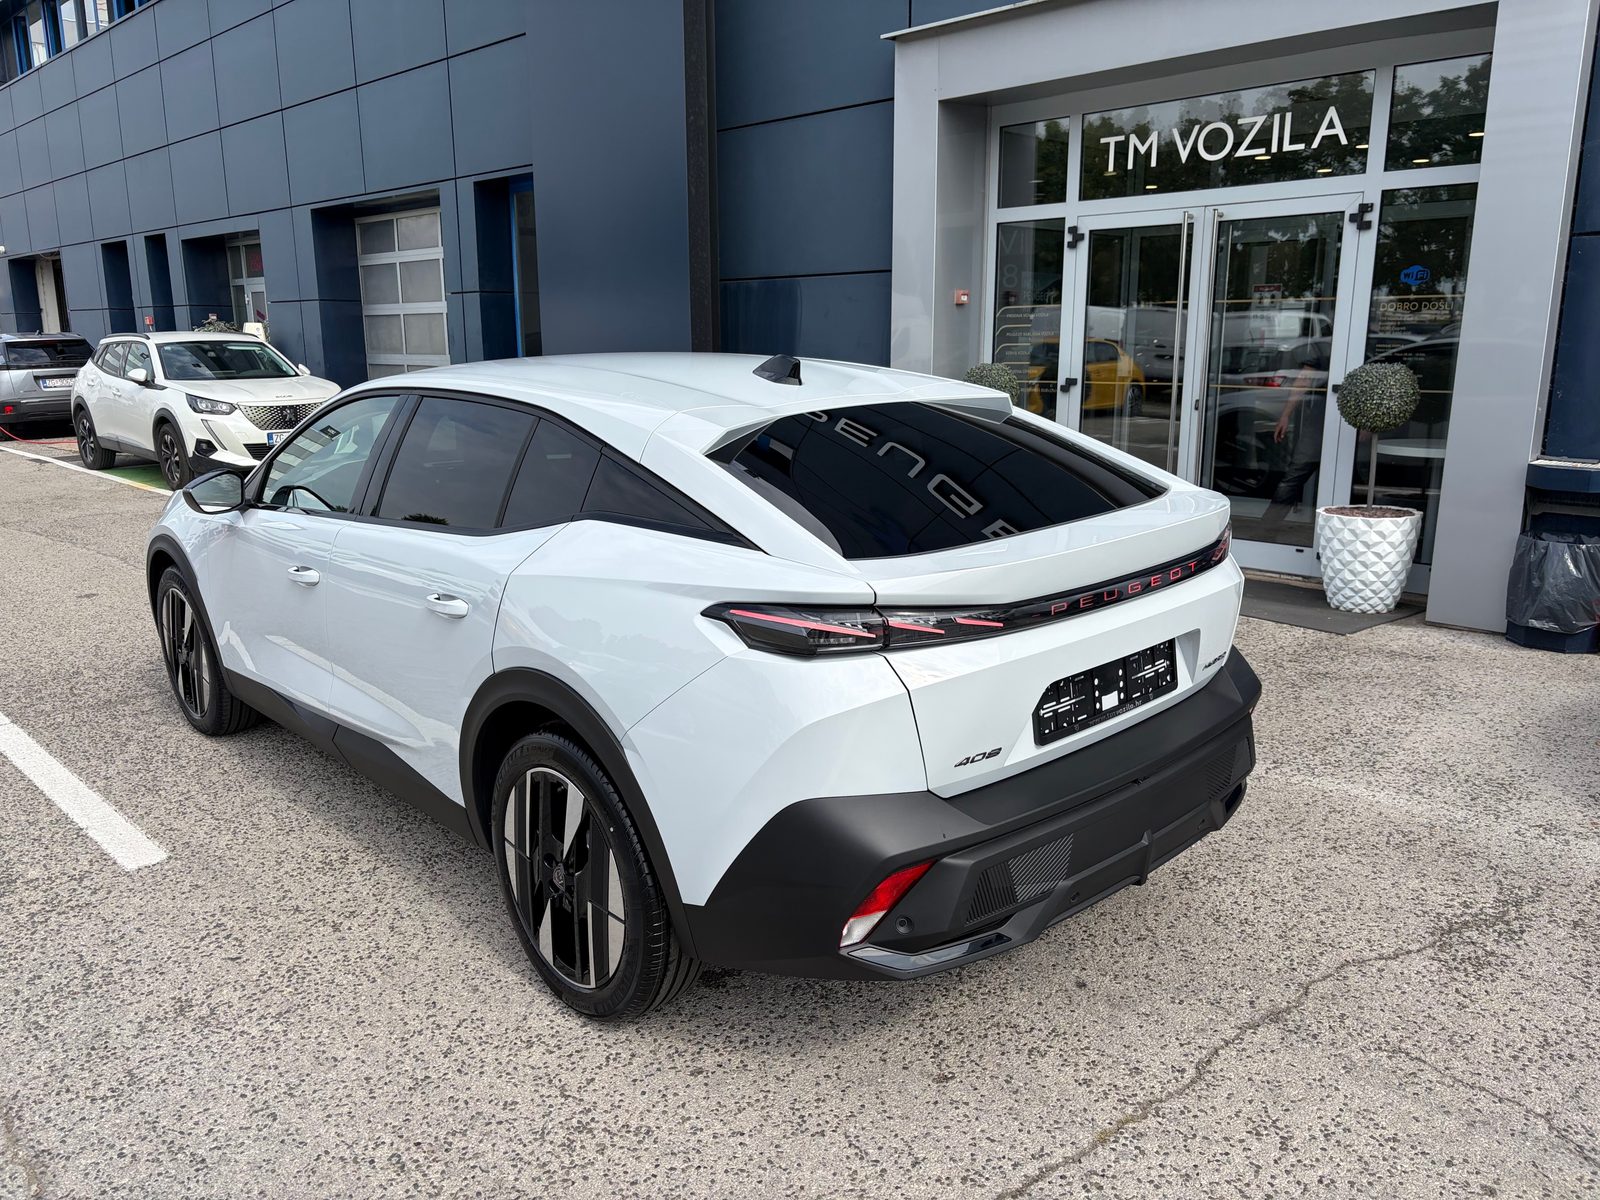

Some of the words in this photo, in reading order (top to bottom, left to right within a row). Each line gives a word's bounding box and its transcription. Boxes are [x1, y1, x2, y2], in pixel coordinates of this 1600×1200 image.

[1100, 130, 1158, 172] TM
[1172, 105, 1349, 164] VOZILA
[1380, 302, 1419, 311] DOBRO
[1050, 561, 1198, 616] PEUGEOT
[954, 747, 1003, 768] 408
